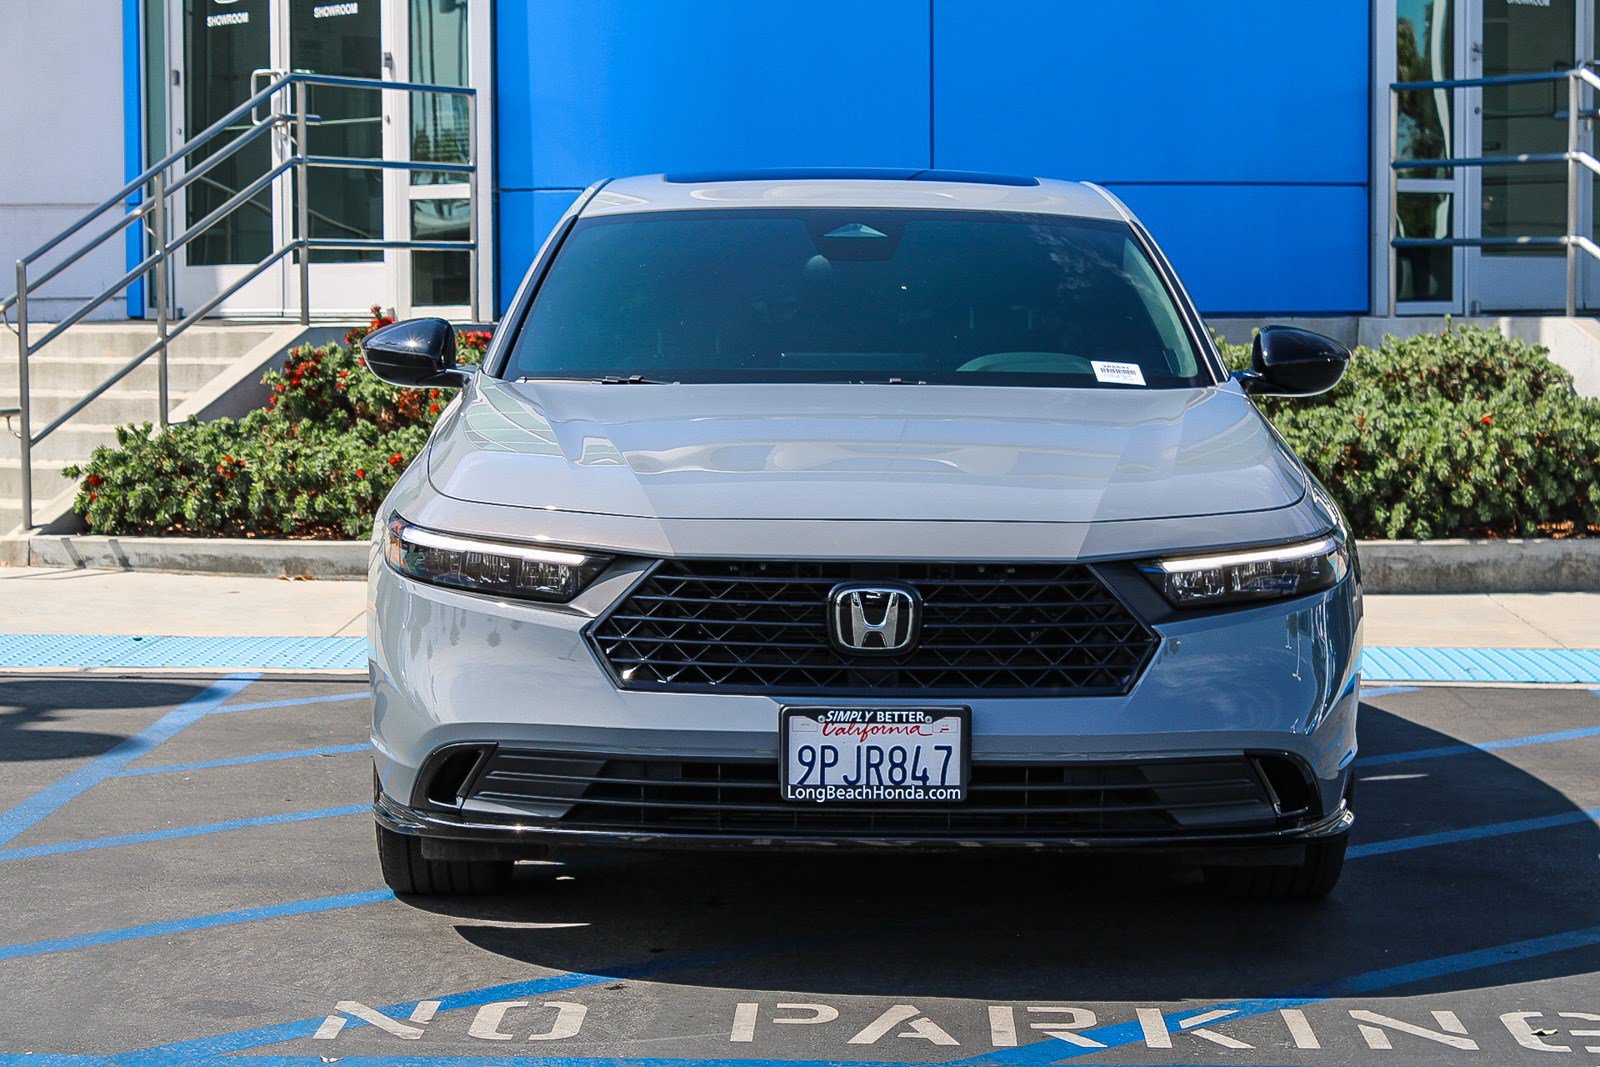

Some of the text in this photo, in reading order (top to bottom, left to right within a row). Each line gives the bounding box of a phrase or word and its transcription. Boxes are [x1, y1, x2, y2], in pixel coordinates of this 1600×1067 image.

[313, 3, 358, 18] SHOWROOM
[206, 12, 249, 27] SHOWROOM
[825, 710, 925, 723] SIMPLY BETTER
[822, 722, 933, 743] California
[797, 745, 953, 786] 9PJR847
[787, 785, 961, 802] LongBeachHonda.com
[312, 1000, 1600, 1053] NO PARKING
